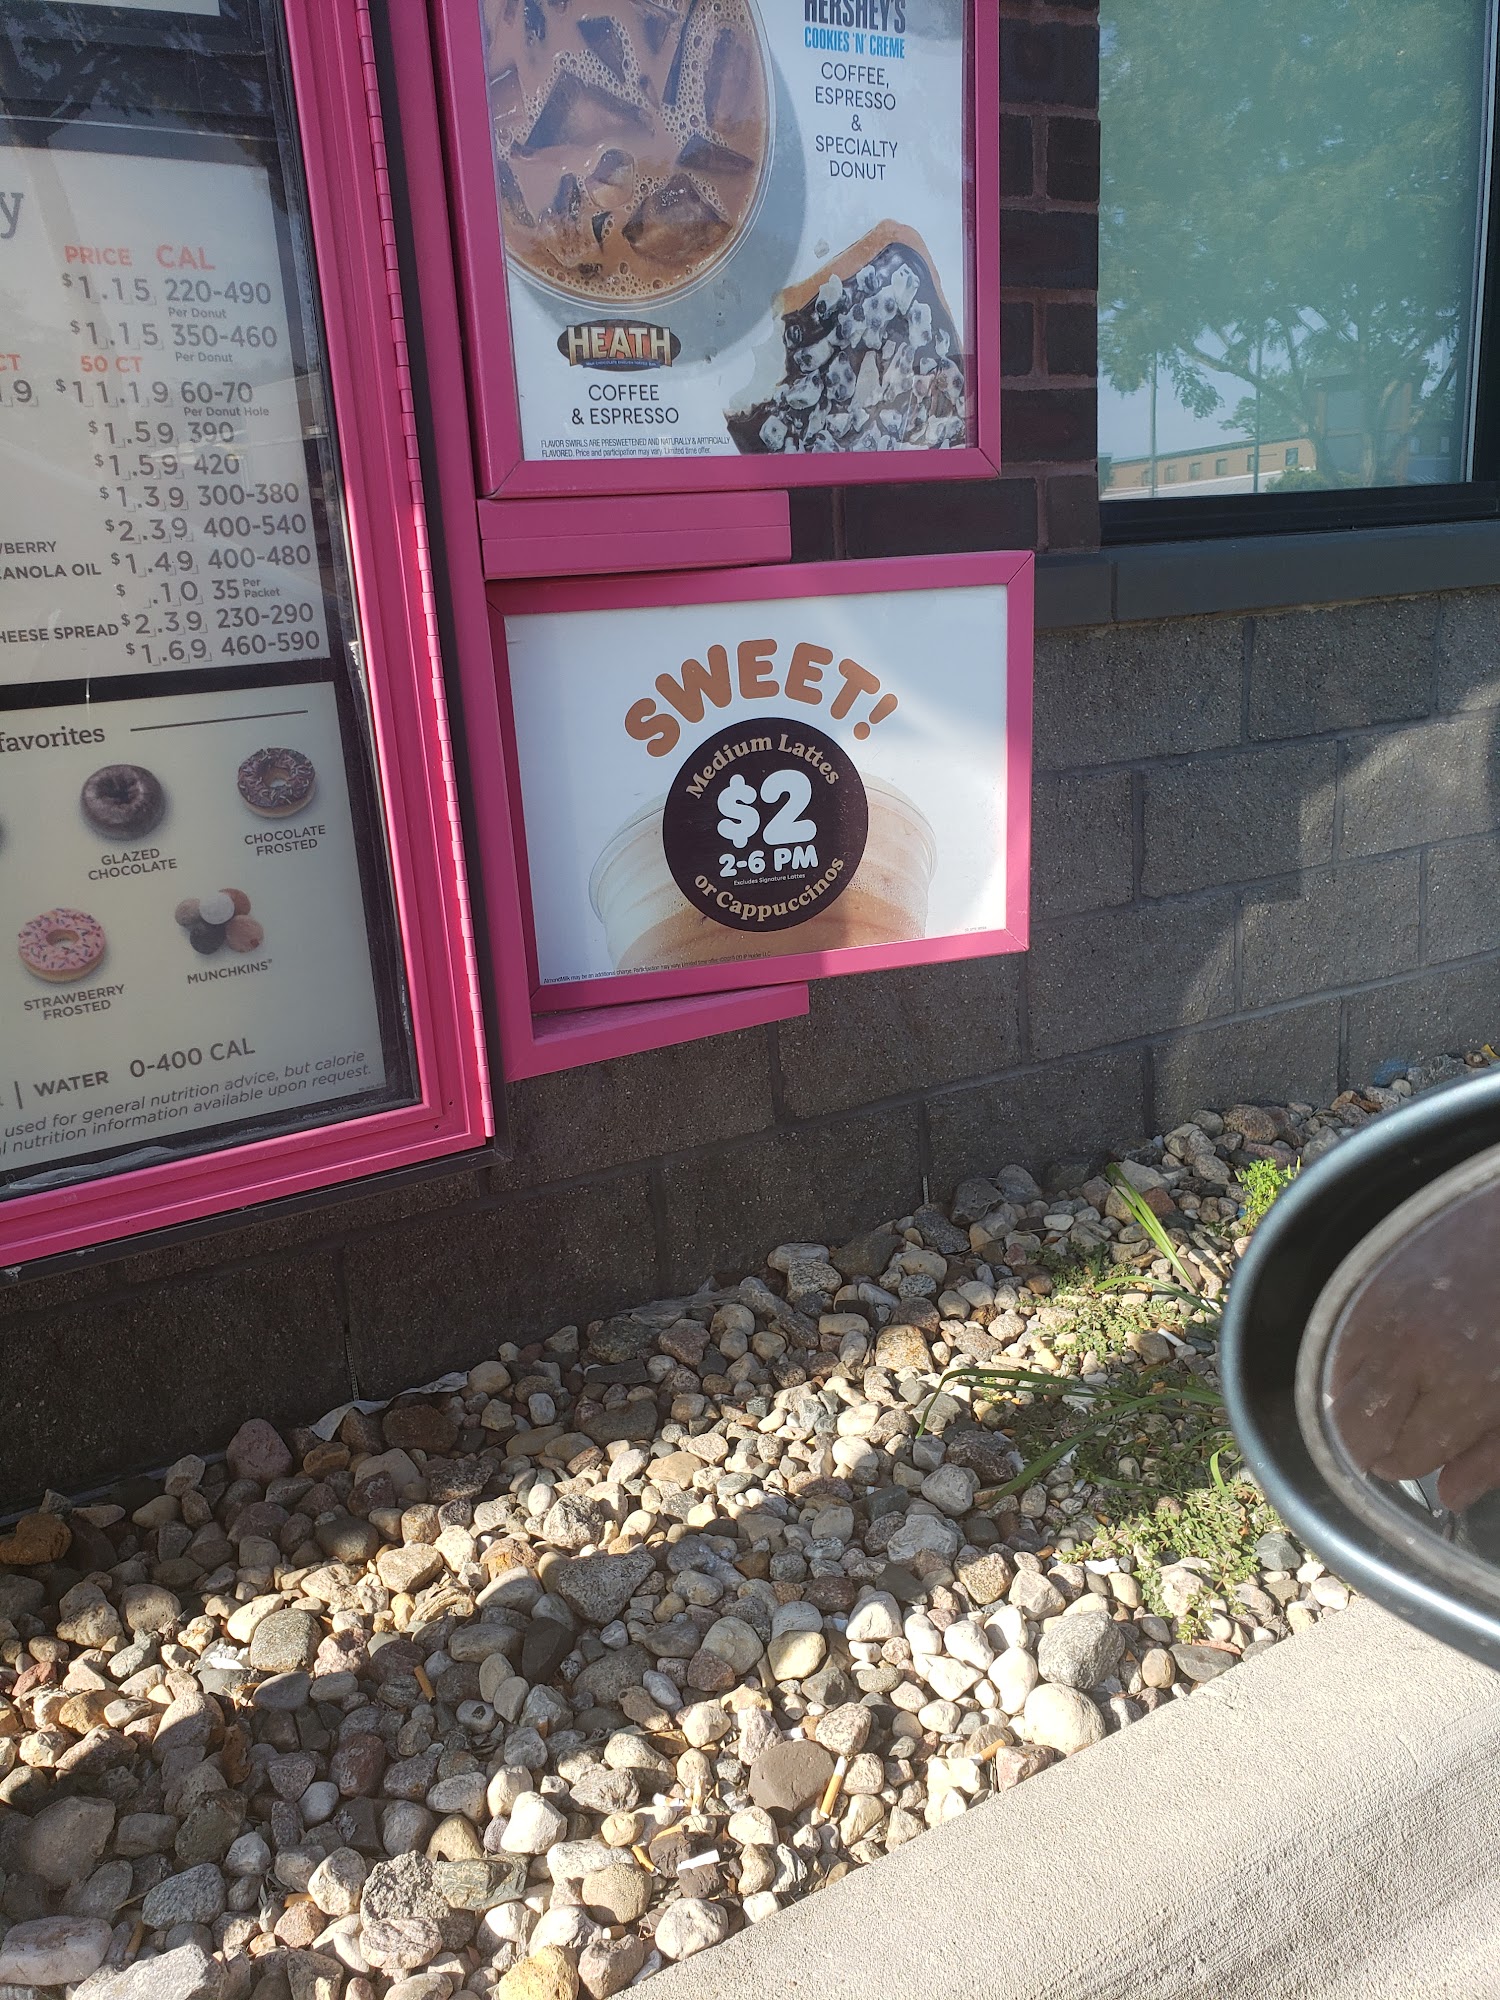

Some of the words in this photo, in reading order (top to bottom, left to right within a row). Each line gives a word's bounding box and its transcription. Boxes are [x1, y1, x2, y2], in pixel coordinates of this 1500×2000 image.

[804, 0, 906, 33] HERSHEY'S
[804, 26, 850, 53] COOKIES
[869, 35, 905, 59] CREME
[821, 62, 889, 89] COFFEE,
[815, 86, 896, 111] ESPRESSO
[851, 114, 862, 132] &
[815, 135, 898, 158] SPECIALTY
[829, 160, 886, 181] DONUT
[64, 246, 132, 267] PRICE
[156, 245, 216, 271] CAL
[164, 278, 272, 304] 220-490
[168, 307, 188, 318] Per
[190, 307, 227, 319] Donut
[172, 323, 278, 348] 350-460
[567, 326, 673, 367] HEATH
[80, 356, 108, 373] 50
[115, 356, 143, 374] CT
[175, 352, 195, 362] Per
[197, 352, 233, 364] Donut
[181, 382, 252, 404] 60-70
[588, 384, 660, 401] COFFEE
[184, 407, 203, 417] Per
[206, 407, 241, 417] Donut
[244, 406, 270, 416] Hole
[571, 408, 584, 425] &
[590, 407, 679, 425] ESPRESSO
[187, 421, 235, 443] 390
[541, 439, 564, 448] FLAVOR
[565, 439, 588, 447] SWIRLS
[588, 438, 600, 447] ARE
[601, 437, 647, 447] PRESWEETENED
[647, 437, 660, 446] AND
[660, 436, 691, 445] NATURALLY
[697, 436, 730, 445] ARTIFICIALLY
[541, 449, 576, 457] FLAVORED.
[575, 448, 590, 456] Price
[591, 448, 602, 456] and
[603, 448, 637, 457] participation
[638, 448, 650, 456] may
[685, 446, 698, 455] time
[194, 453, 240, 475] 420
[198, 482, 299, 507] 300-380
[203, 514, 307, 538] 400-540
[0, 565, 67, 580] ANOLA
[72, 563, 102, 576] OIL
[208, 545, 311, 570] 400-480
[212, 580, 240, 600] 35
[243, 577, 261, 587] Per
[244, 587, 281, 599] Packet
[54, 623, 119, 640] SPREAD
[216, 603, 314, 630] 230-290
[221, 631, 320, 656] 460-590
[624, 638, 899, 758] SWEET!
[0, 726, 106, 752] favorites
[685, 734, 774, 800] Medium
[778, 734, 839, 785] Lattes
[717, 769, 817, 848] $2
[244, 824, 326, 846] CHOCOLATE
[101, 848, 160, 867] GLAZED
[256, 838, 318, 857] FROSTED
[88, 858, 178, 881] CHOCOLATE
[719, 850, 766, 877] 2-6
[774, 845, 819, 871] PM
[694, 874, 717, 896] or
[715, 857, 844, 921] Cappuccinos
[733, 877, 758, 885] Excludes
[759, 874, 787, 883] Signature
[24, 984, 125, 1011] STRAWBERRY
[43, 999, 111, 1021] FROSTED
[33, 1071, 109, 1097] WATER
[129, 1048, 203, 1078] 0-400
[210, 1038, 256, 1061] CAL
[5, 1117, 46, 1138] used
[52, 1113, 78, 1128] for
[83, 1096, 146, 1123] general
[150, 1082, 219, 1106] nutrition
[224, 1071, 279, 1091] advice,
[285, 1062, 310, 1078] but
[315, 1051, 365, 1071] calorie
[13, 1127, 87, 1152] nutrition
[93, 1103, 188, 1135] information
[193, 1088, 263, 1113] available
[268, 1080, 307, 1097] upon
[312, 1064, 371, 1086] request.
